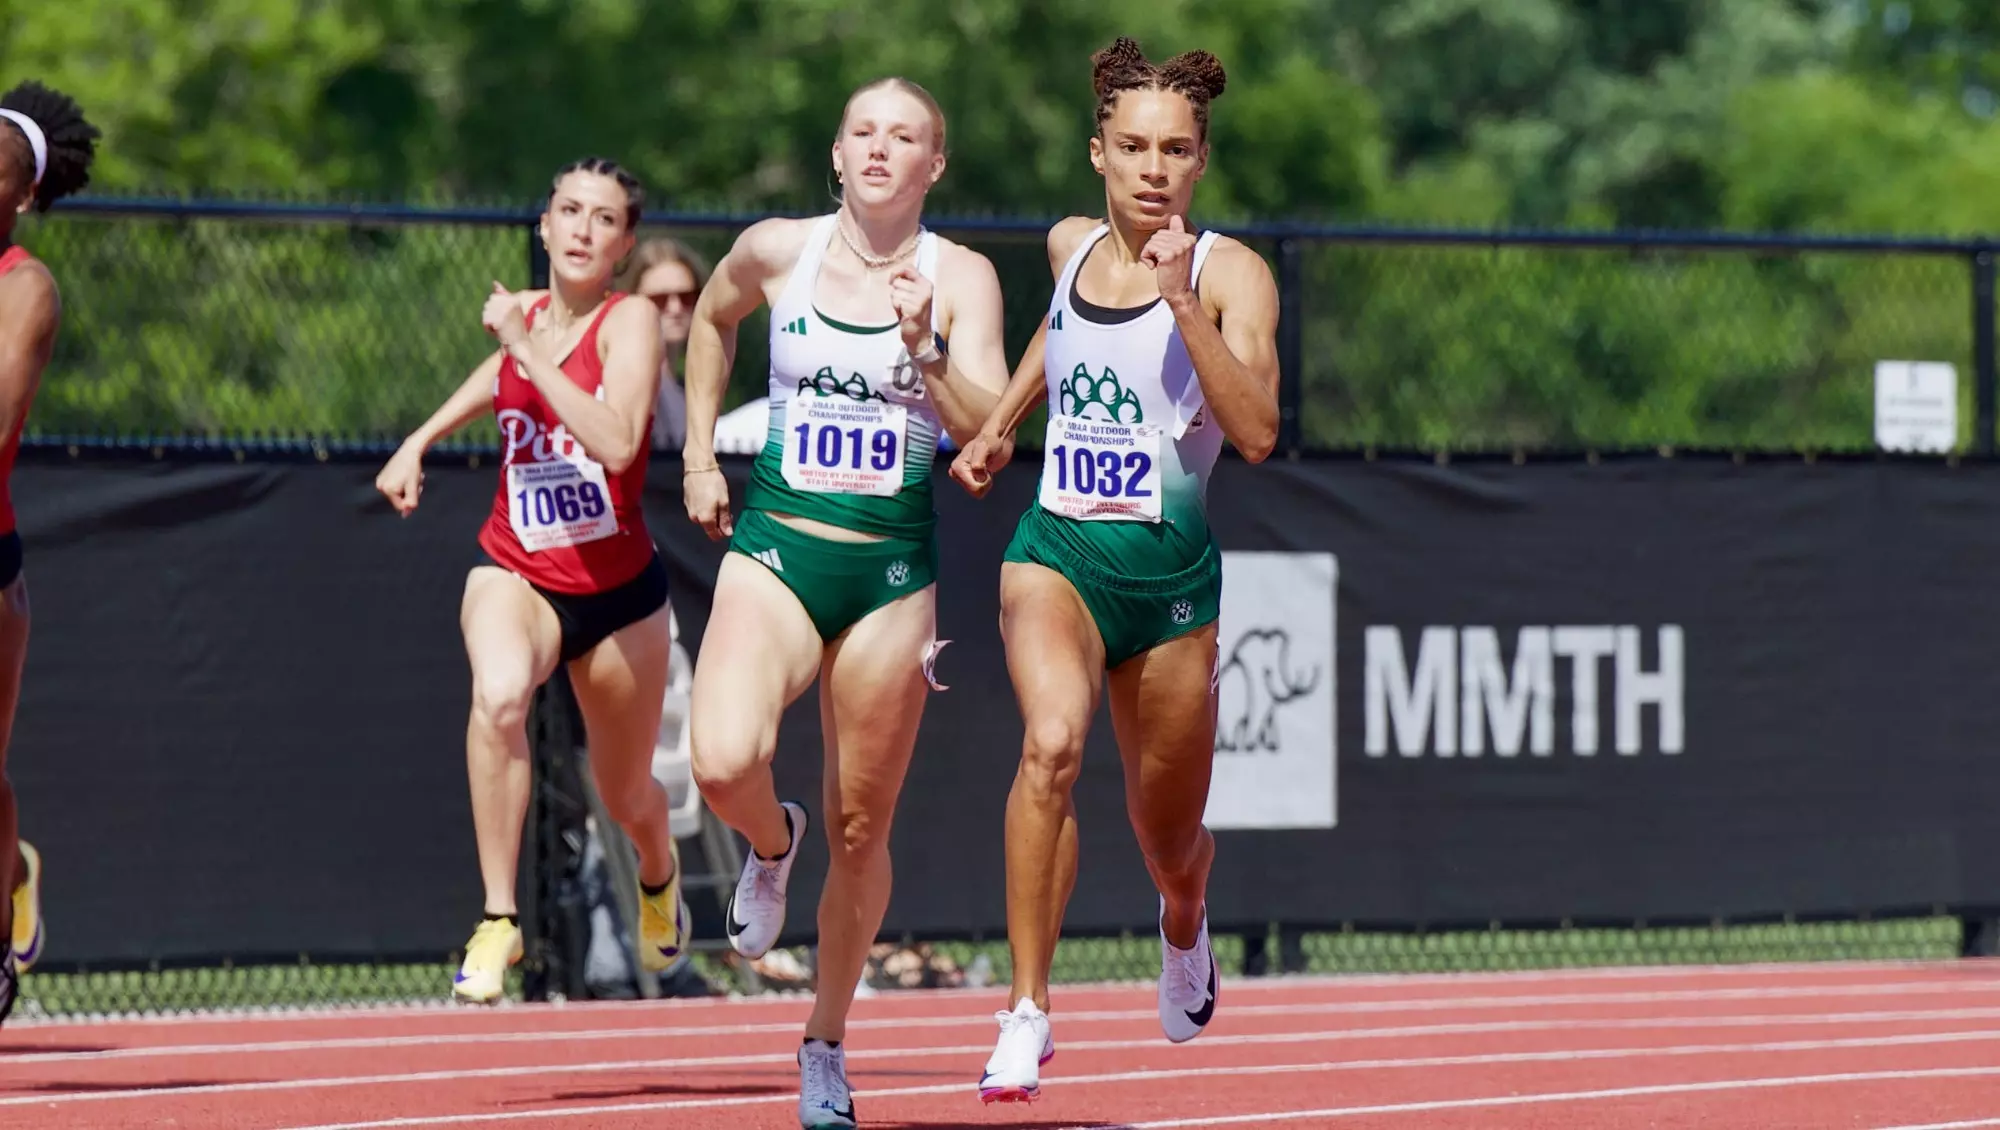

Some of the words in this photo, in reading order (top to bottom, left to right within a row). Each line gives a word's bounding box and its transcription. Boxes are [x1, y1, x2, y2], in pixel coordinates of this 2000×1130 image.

[808, 410, 883, 423] CHAMPIONSHIPS
[838, 404, 880, 414] OUTDOOR
[1064, 431, 1135, 446] CHAMPIONSHIPS
[1090, 424, 1131, 436] OUTDOOR
[794, 422, 897, 472] 1019
[1052, 444, 1152, 498] 1032
[517, 481, 605, 527] 1069
[1365, 624, 1685, 757] MMTH
